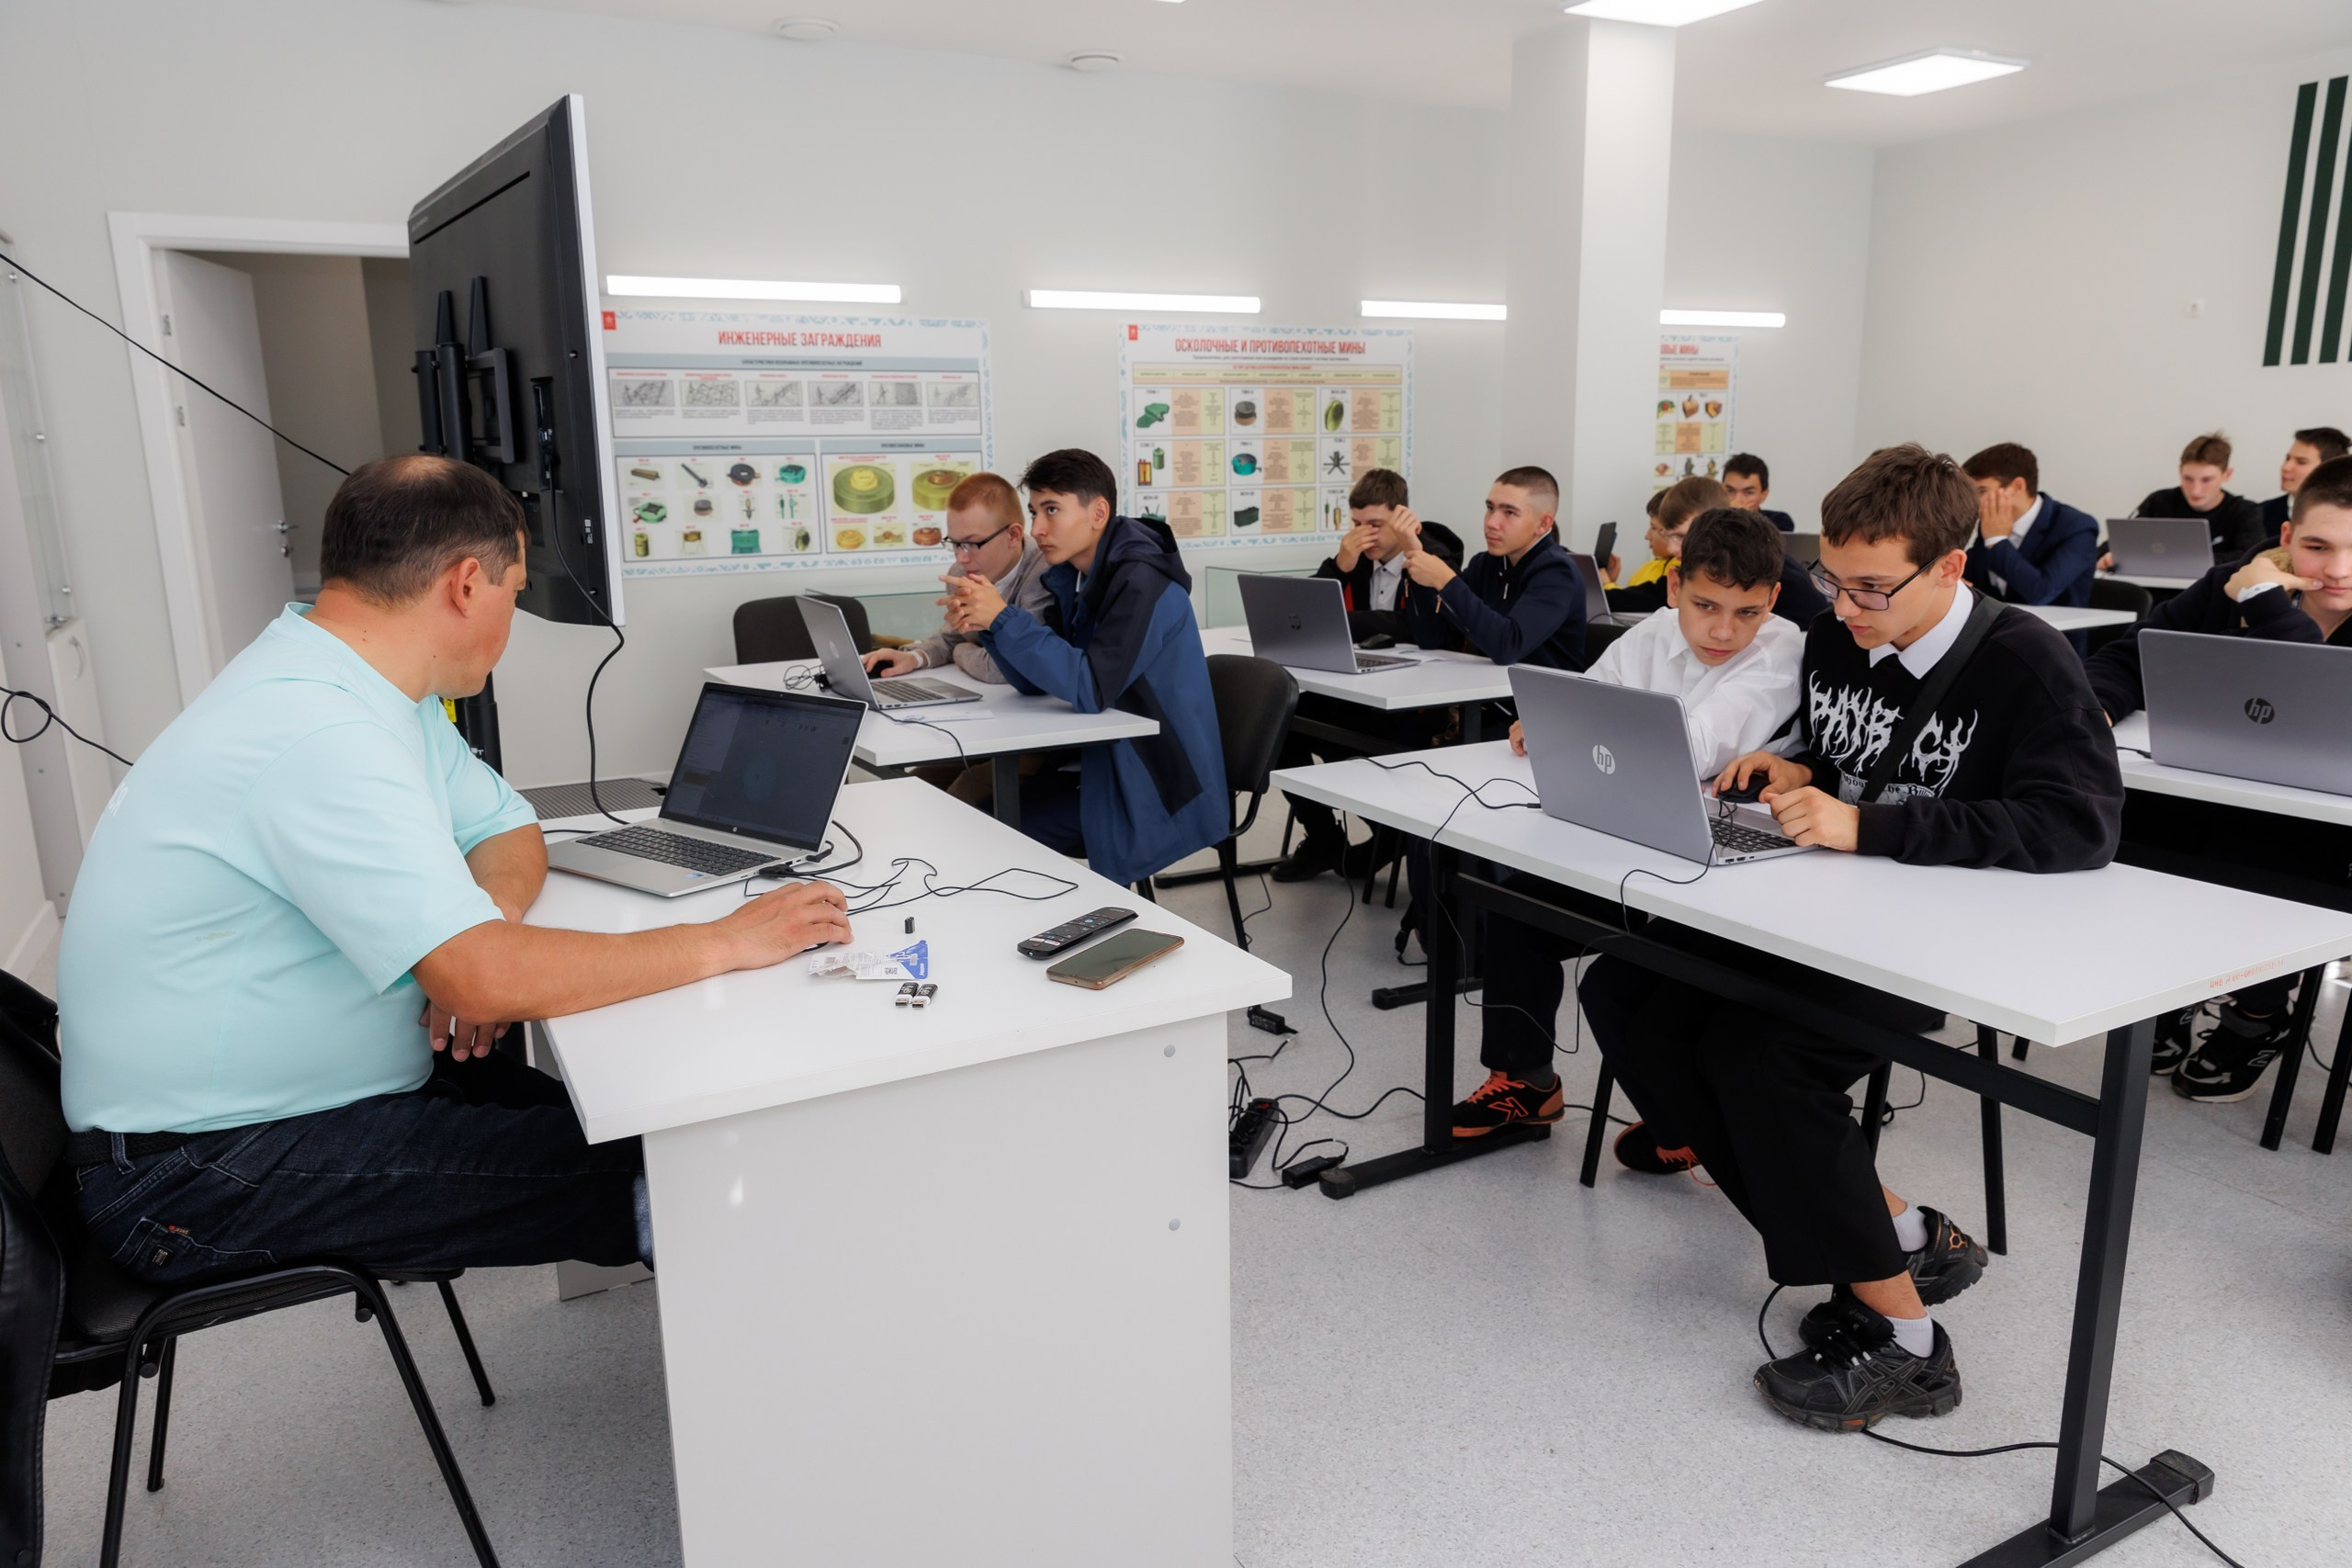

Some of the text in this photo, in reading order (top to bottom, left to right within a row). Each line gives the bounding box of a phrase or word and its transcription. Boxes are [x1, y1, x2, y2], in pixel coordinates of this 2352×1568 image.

[718, 331, 882, 348] ИНЖЕНЕРНЫЕ ЗАГРАЖДЕНИЯ
[1175, 338, 1365, 355] ОСКОЛОЧНЫЕ И ПРОТИВОПЕХОТНЫЕ МИНЫ
[2245, 698, 2273, 725] hp
[1595, 745, 1614, 774] hp
